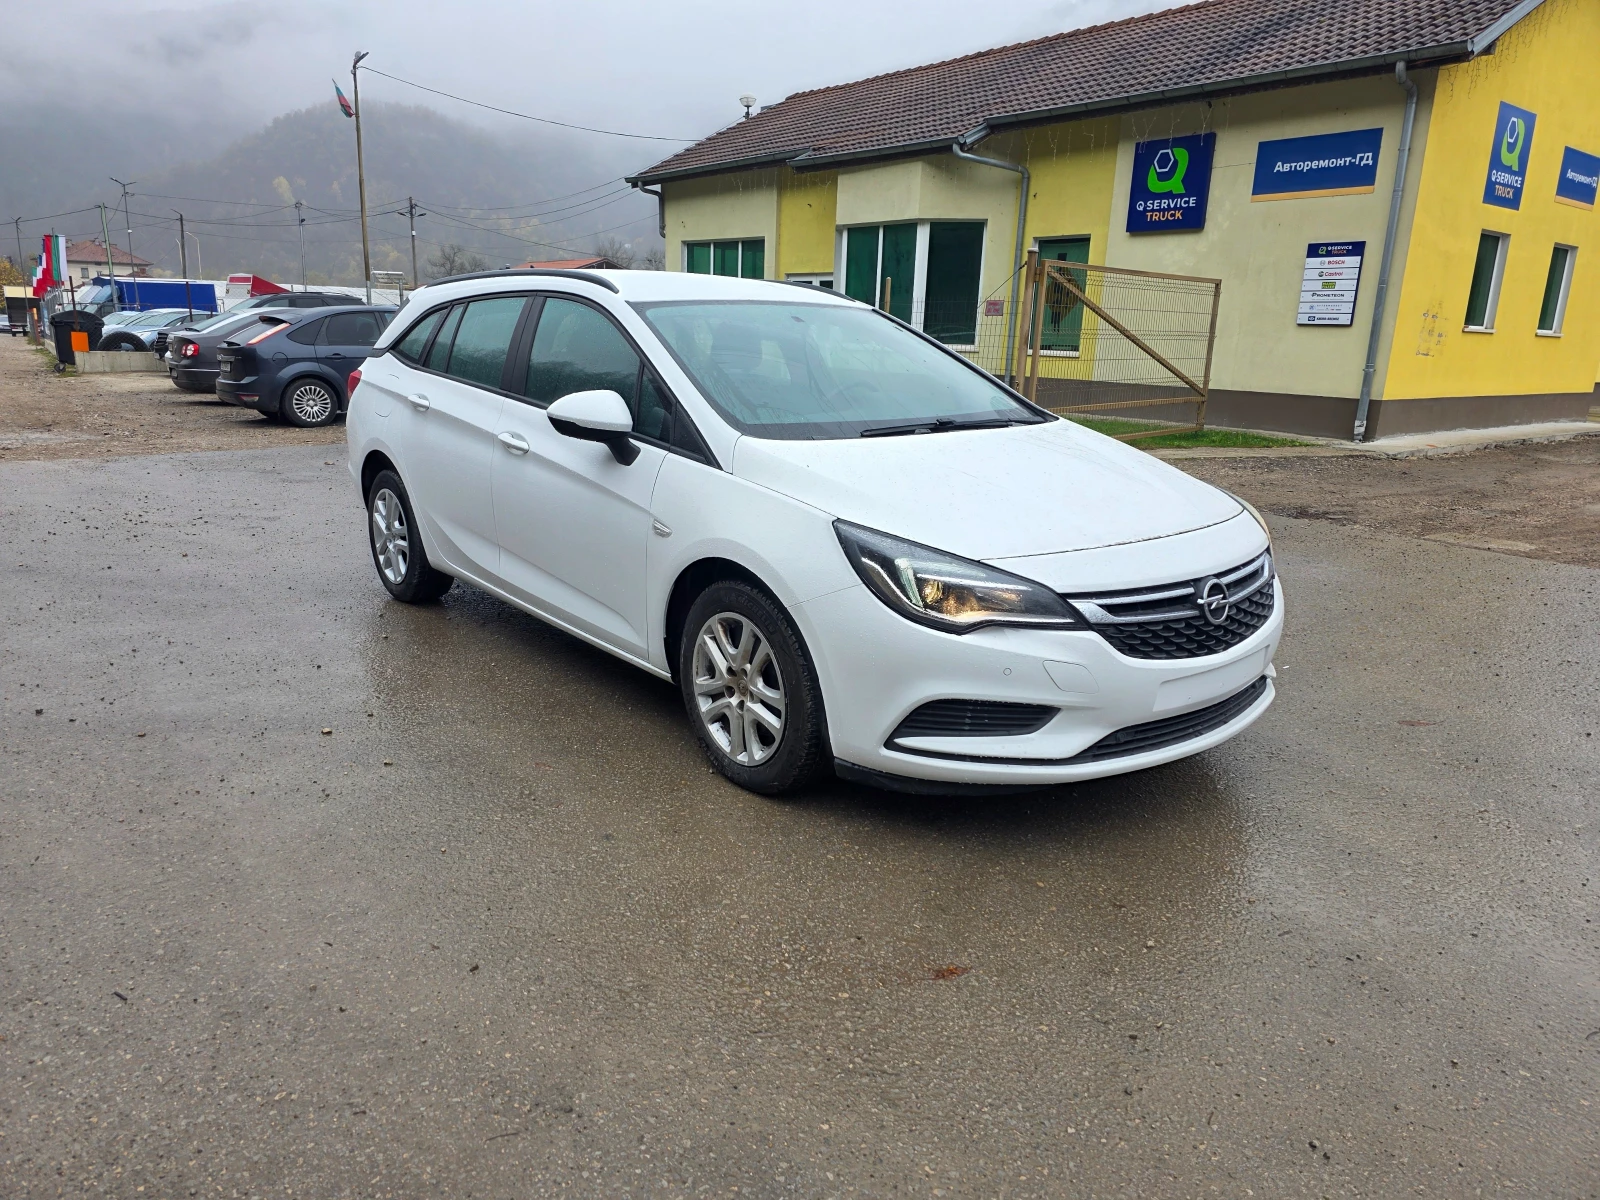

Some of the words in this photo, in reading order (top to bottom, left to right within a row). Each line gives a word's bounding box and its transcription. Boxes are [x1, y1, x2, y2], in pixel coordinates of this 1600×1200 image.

[1273, 152, 1373, 173] Авторемонт-ГД
[1494, 184, 1514, 200] TRUCK
[1145, 209, 1183, 222] TRUCK
